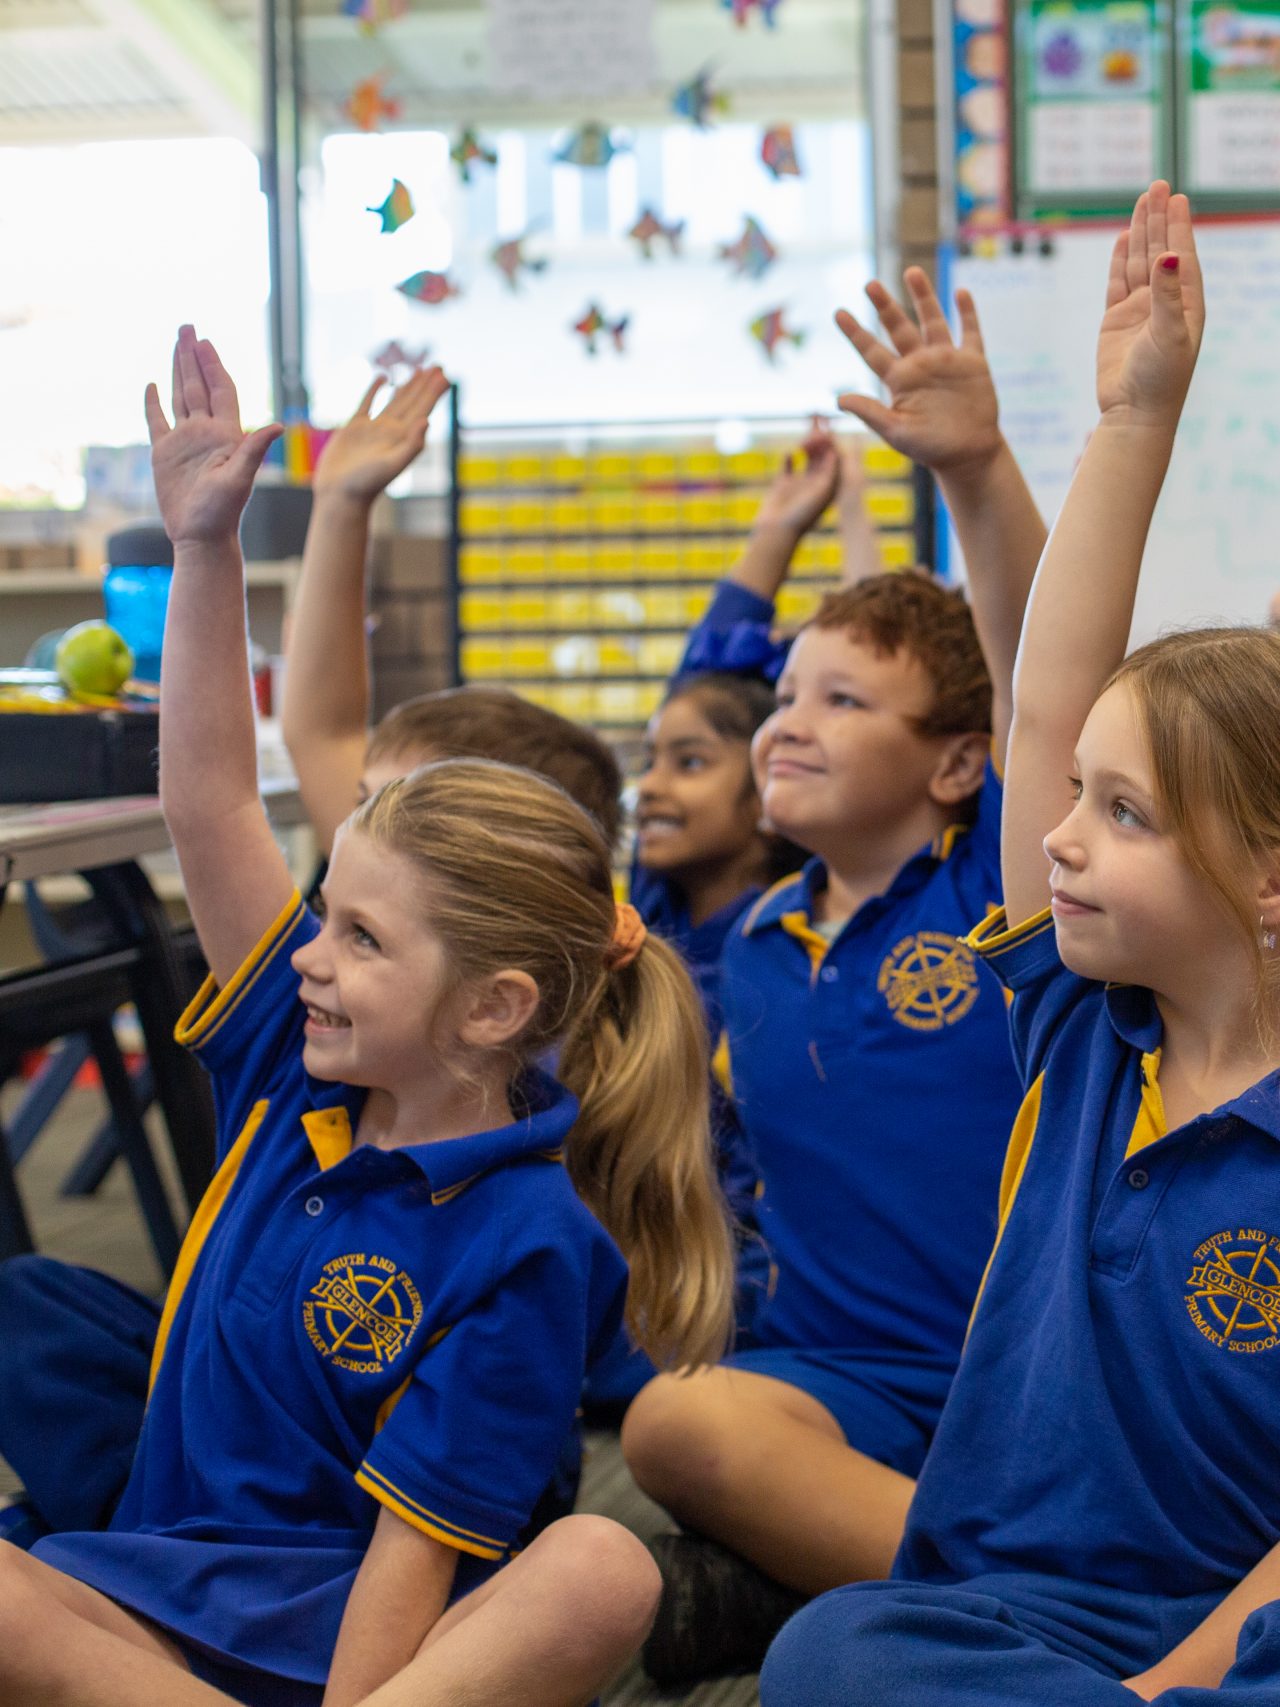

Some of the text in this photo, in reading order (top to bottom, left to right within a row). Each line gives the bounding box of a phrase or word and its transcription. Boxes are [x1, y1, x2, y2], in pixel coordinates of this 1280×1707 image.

[322, 1253, 366, 1275] TRUTH
[368, 1255, 397, 1274] AND
[1193, 1231, 1232, 1261] TRUTH
[1237, 1229, 1267, 1241] AND
[304, 1302, 383, 1373] PRIMARY SCHOOL
[332, 1284, 398, 1342] GLENCOE
[1184, 1295, 1280, 1353] PRIMARY SCHOOL
